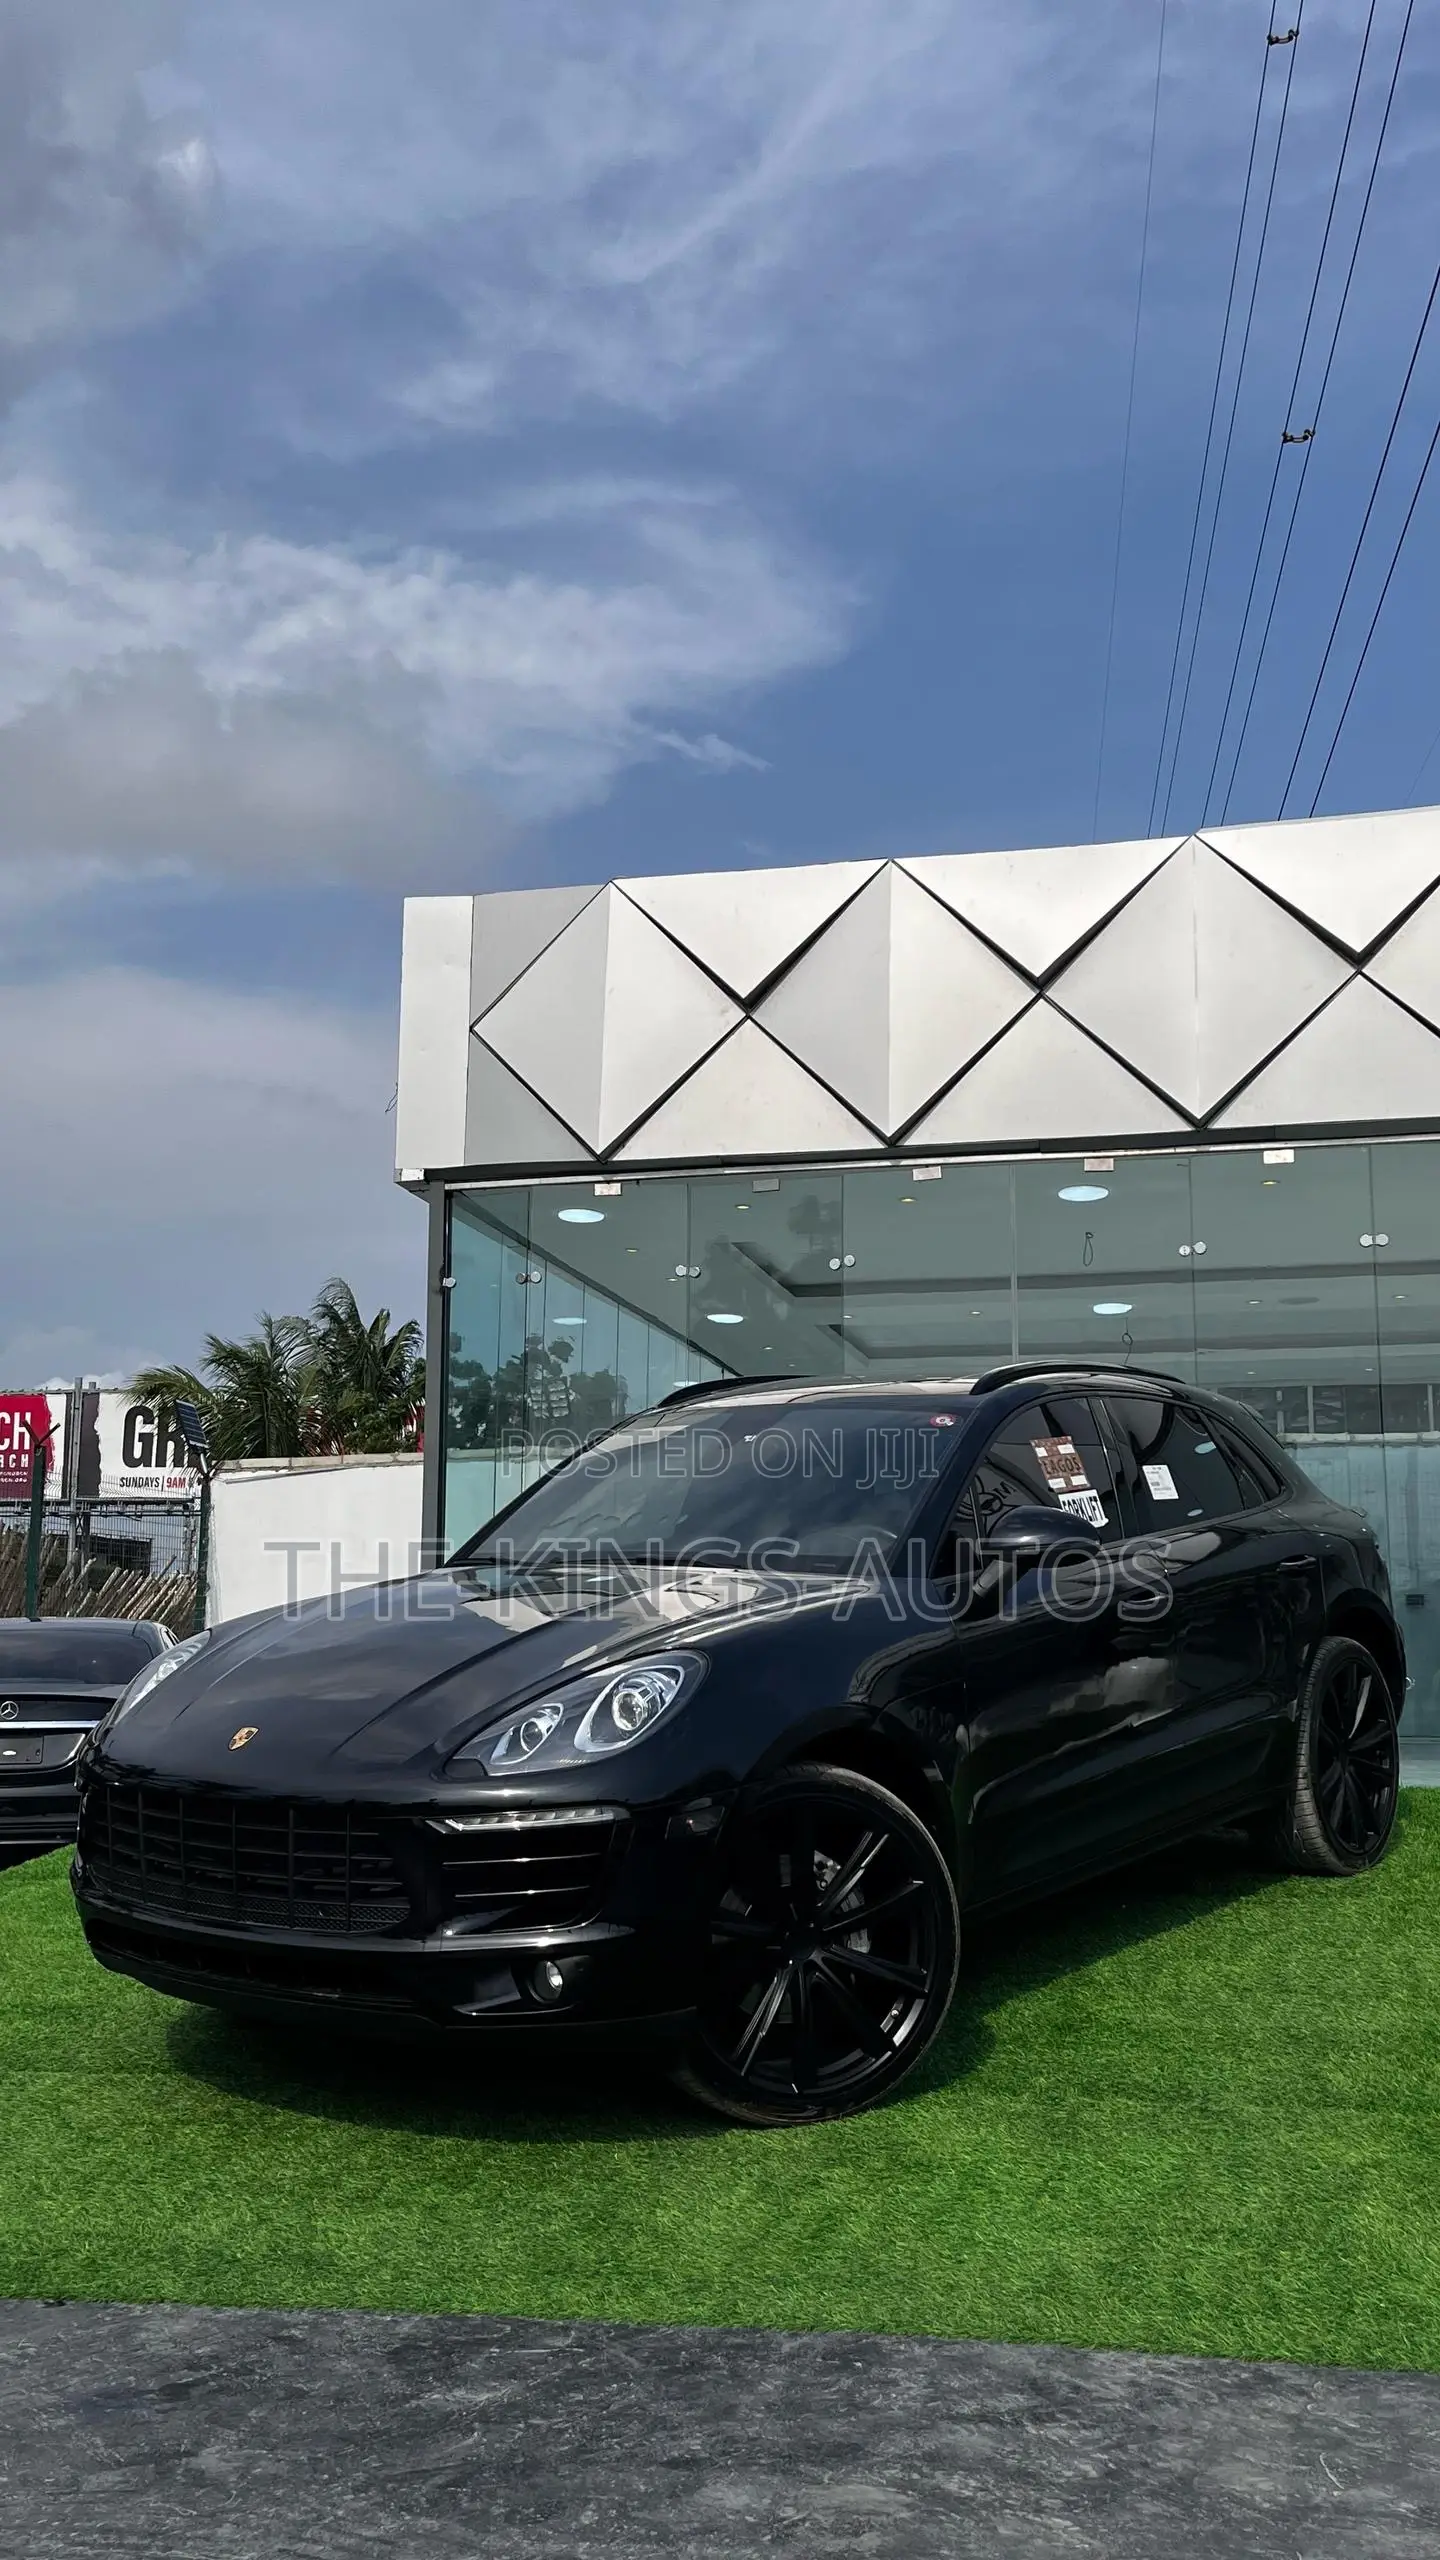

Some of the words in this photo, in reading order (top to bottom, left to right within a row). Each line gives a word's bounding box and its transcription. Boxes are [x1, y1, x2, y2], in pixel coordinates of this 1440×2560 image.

[1042, 1456, 1082, 1475] LAGOS
[119, 1476, 160, 1488] SUNDAYS
[166, 1476, 187, 1489] 9AM
